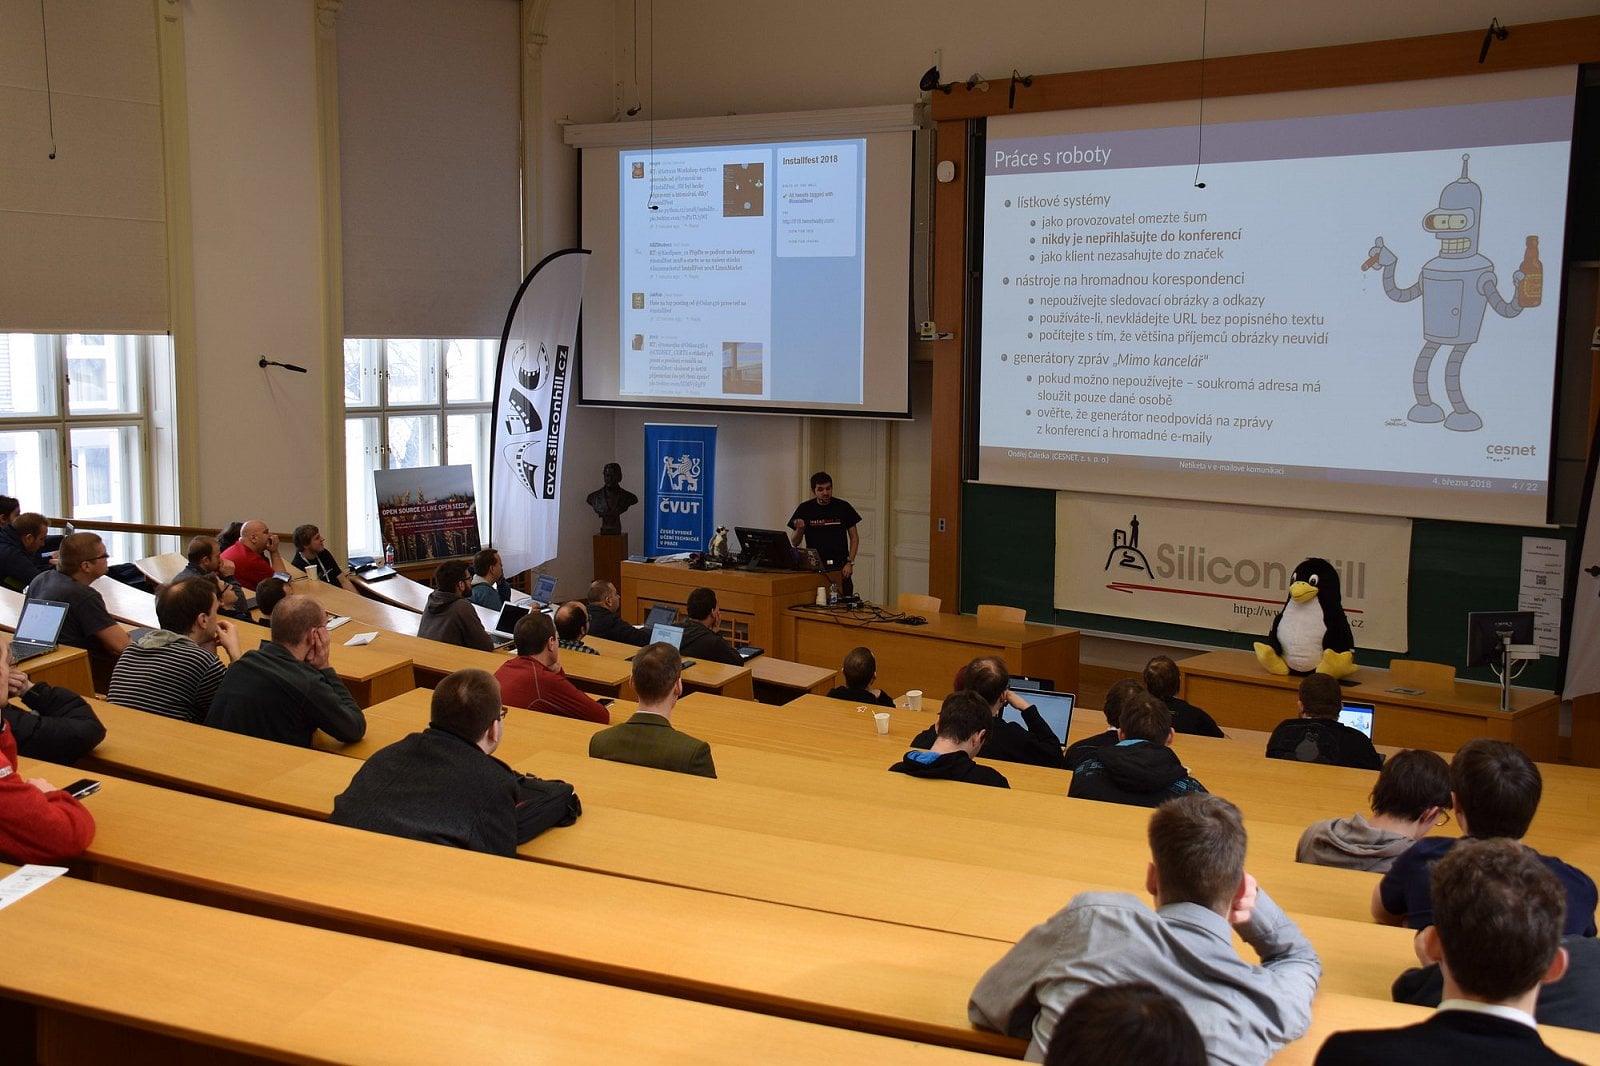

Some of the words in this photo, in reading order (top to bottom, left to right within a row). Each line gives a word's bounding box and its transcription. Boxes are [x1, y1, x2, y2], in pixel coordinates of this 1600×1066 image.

[782, 155, 819, 165] Installfest
[820, 154, 838, 164] 2018
[994, 149, 1038, 168] Práce
[1043, 152, 1051, 165] s
[1056, 146, 1112, 165] roboty
[1017, 194, 1060, 209] lístkové
[1063, 193, 1111, 208] systémy
[1041, 216, 1063, 229] jako
[1066, 213, 1135, 227] provozovatel
[1138, 213, 1179, 224] omezte
[1183, 211, 1207, 222] šum
[1042, 233, 1071, 246] nikdy
[1072, 234, 1083, 245] je
[1086, 230, 1157, 245] nepřihlašujte
[1161, 230, 1175, 242] do
[1178, 228, 1242, 241] konferencí
[1040, 251, 1062, 264] jako
[1065, 250, 1095, 262] klient
[1098, 249, 1162, 263] nezasahujte
[1166, 249, 1180, 260] do
[1183, 248, 1223, 260] značek
[1015, 274, 1060, 289] nástroje
[1063, 276, 1078, 286] na
[1081, 273, 1148, 286] hromadnou
[1152, 272, 1245, 288] korespondenci
[1040, 293, 1107, 309] nepoužívejte
[1110, 294, 1161, 306] sledovací
[1164, 294, 1209, 308] obrázky
[1212, 298, 1219, 306] a
[1222, 294, 1265, 309] odkazy
[1039, 312, 1103, 327] používáte-li,
[1106, 312, 1169, 328] nevkládejte
[1173, 314, 1197, 324] URL
[1201, 314, 1221, 325] bez
[1224, 314, 1287, 328] popisného
[1291, 315, 1324, 325] textu
[1039, 329, 1085, 344] počítejte
[1088, 333, 1094, 341] s
[1097, 331, 1116, 344] tím,
[1119, 330, 1132, 342] že
[1135, 331, 1174, 342] většina
[1178, 331, 1227, 347] příjemců
[1231, 332, 1278, 346] obrázky
[1282, 332, 1328, 344] neuvidí
[1013, 351, 1074, 367] generátory
[1078, 353, 1109, 368] zpráv
[1038, 373, 1070, 388] pokud
[1073, 374, 1109, 386] možno
[1112, 374, 1183, 391] nepoužívejte
[1197, 377, 1255, 391] soukromá
[1258, 379, 1298, 392] adresa
[1302, 379, 1321, 392] má
[1038, 390, 1071, 402] sloužit
[1074, 394, 1106, 406] pouze
[1109, 392, 1136, 404] dané
[1139, 392, 1172, 406] osobě
[546, 350, 567, 496] avc.siliconhill.cz
[1037, 407, 1072, 421] ověřte,
[1076, 408, 1088, 420] že
[1091, 409, 1143, 424] generátor
[1147, 411, 1212, 426] neodpovídá
[1216, 416, 1230, 427] na
[1233, 415, 1273, 430] zprávy
[1037, 427, 1042, 435] z
[1045, 423, 1099, 438] konferencí
[1102, 429, 1109, 438] a
[1112, 426, 1168, 441] hromadné
[1171, 431, 1212, 446] e-maily
[1486, 444, 1536, 456] cesnet
[1470, 479, 1492, 488] 2018
[1525, 483, 1538, 491] 22
[660, 498, 700, 514] ČVUT
[1156, 543, 1286, 591] Silicon
